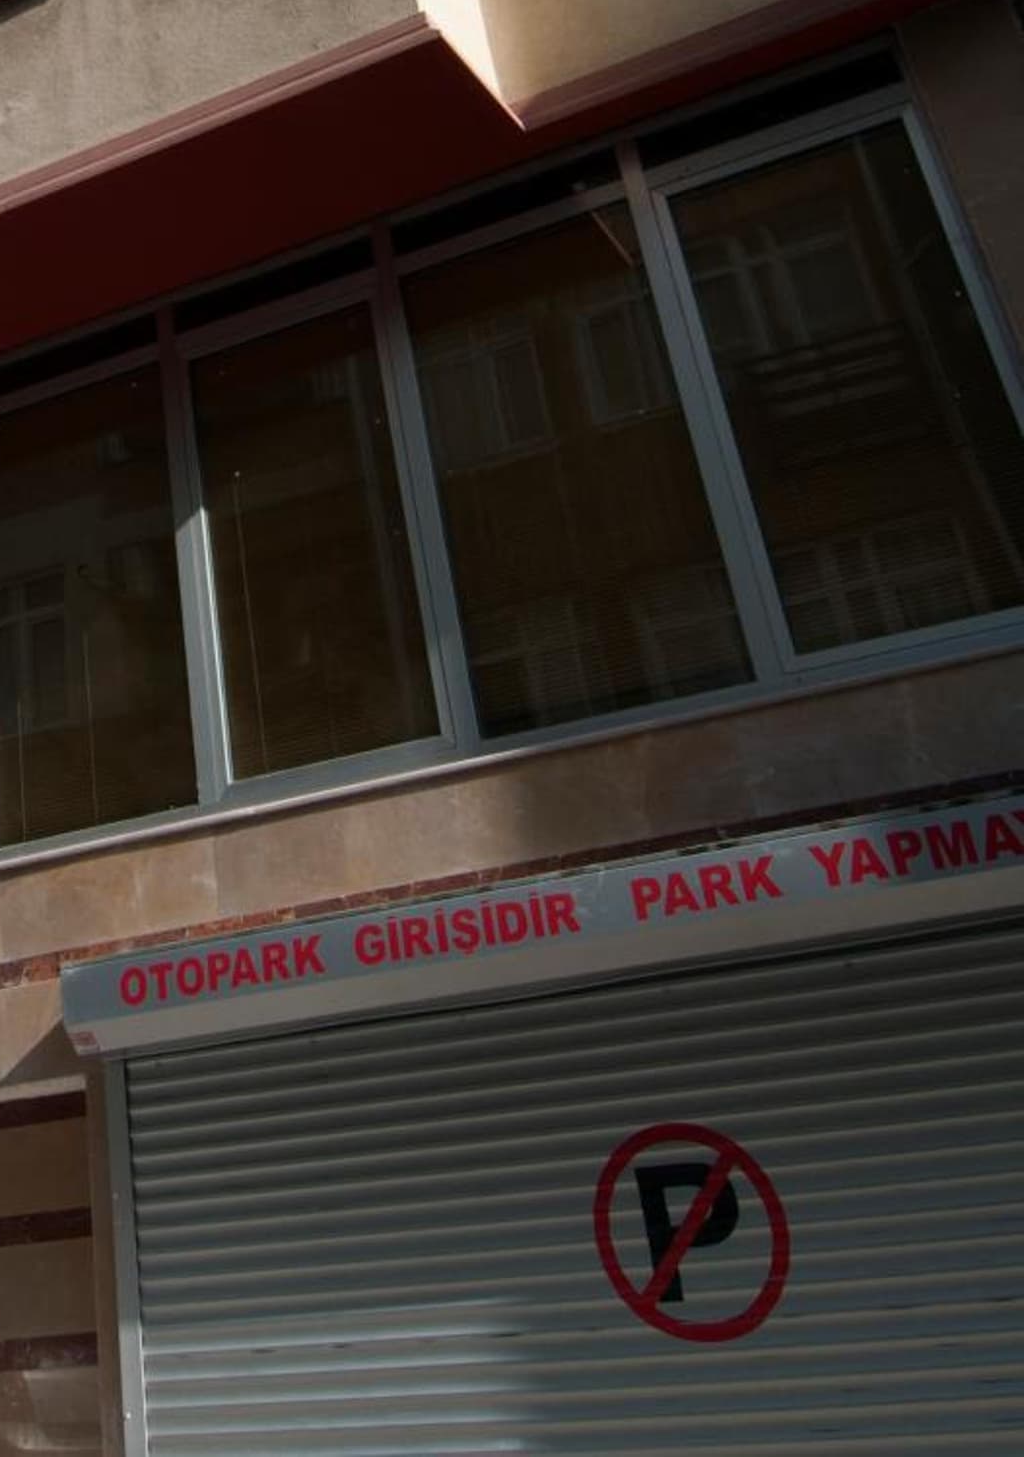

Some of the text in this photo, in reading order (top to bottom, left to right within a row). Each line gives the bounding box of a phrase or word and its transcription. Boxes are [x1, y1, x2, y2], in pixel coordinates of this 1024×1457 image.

[119, 933, 326, 1007] OTOPARK
[354, 892, 580, 966] GİRİŞİDİR
[631, 855, 783, 921] PARK
